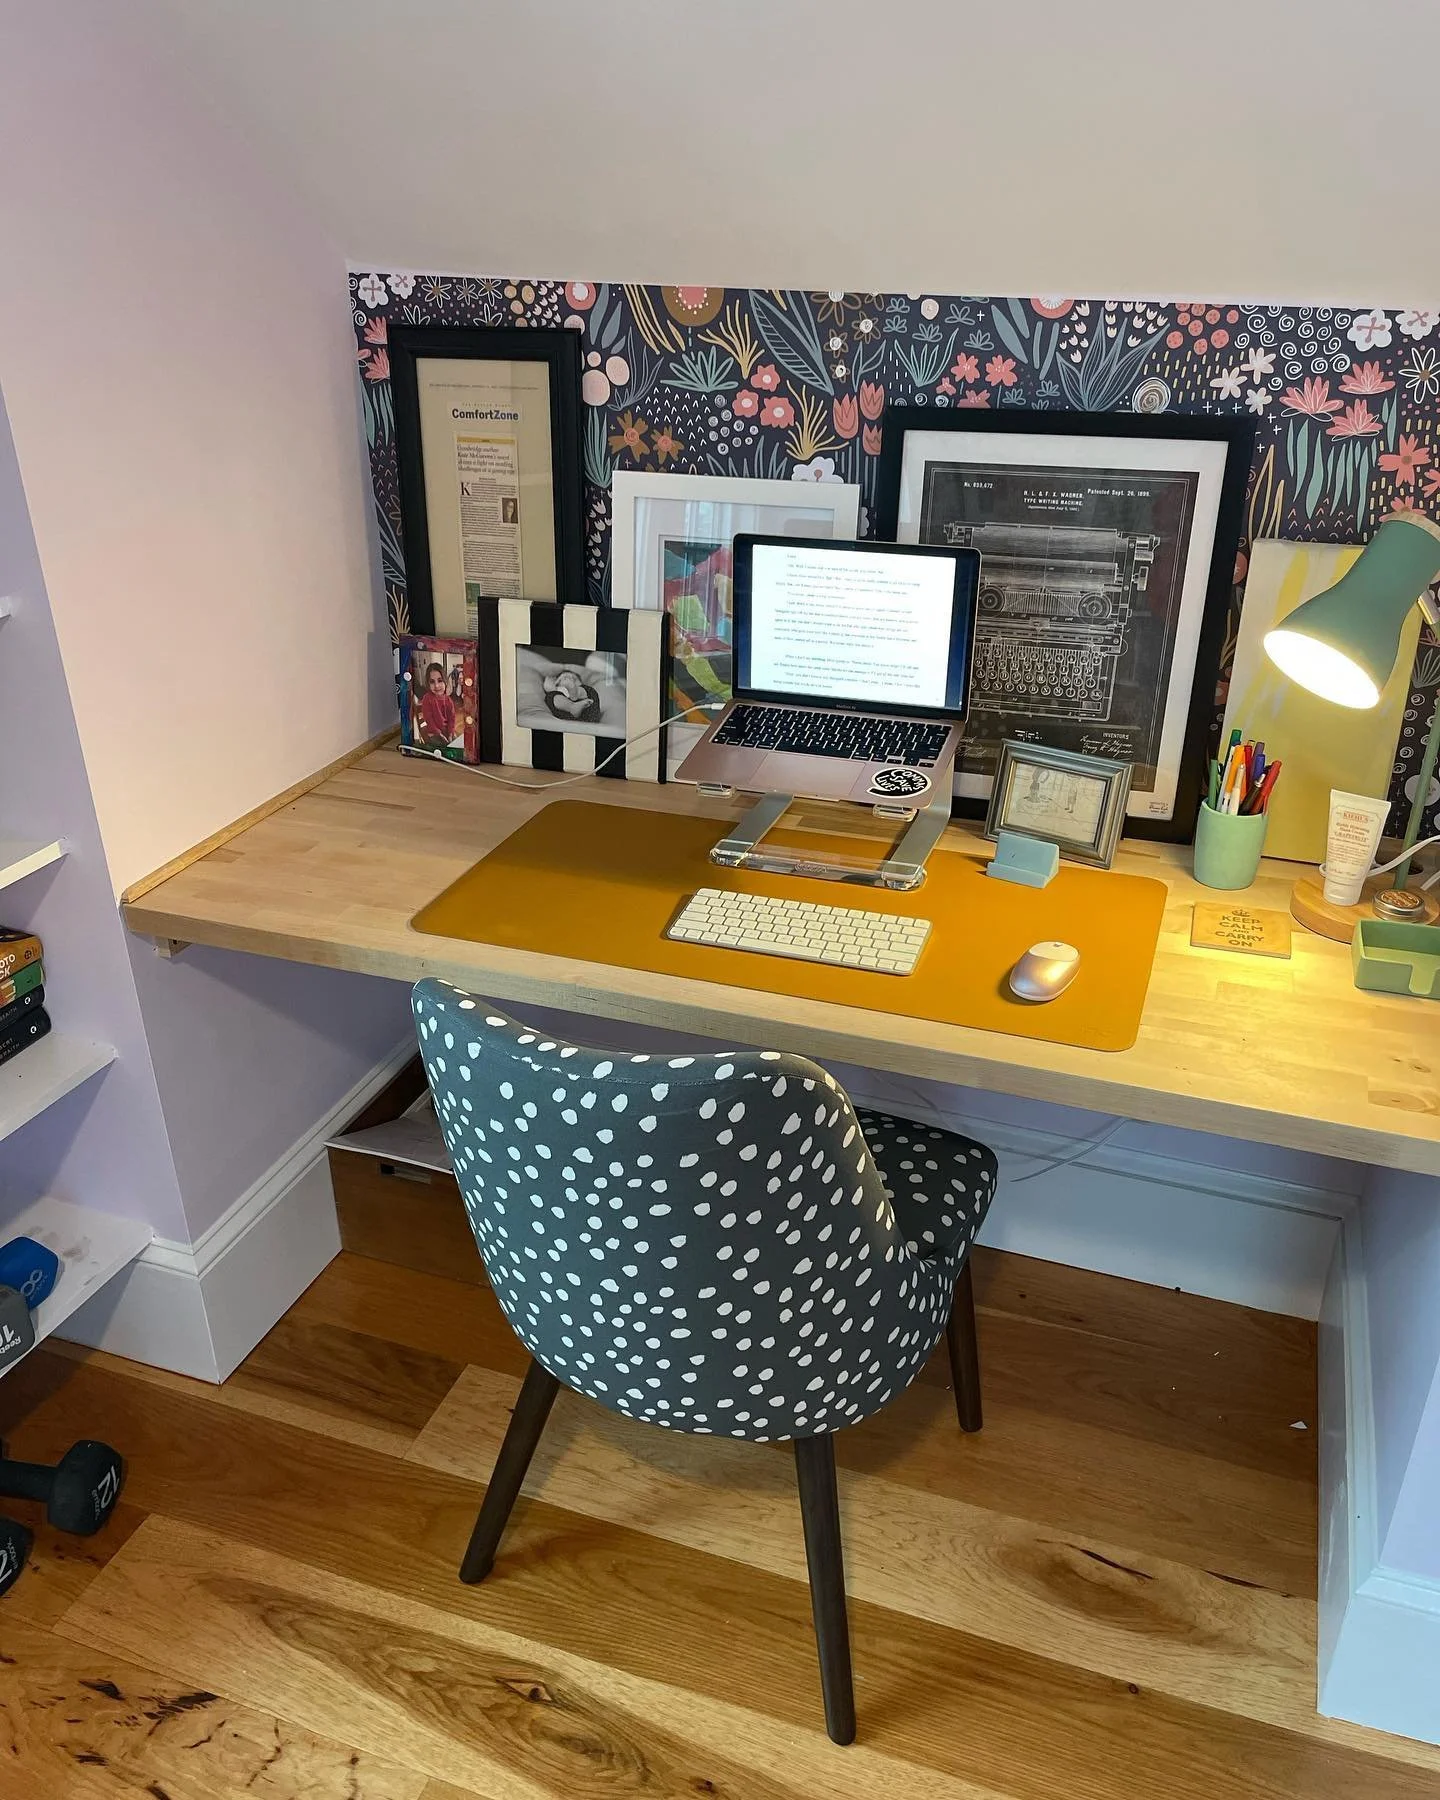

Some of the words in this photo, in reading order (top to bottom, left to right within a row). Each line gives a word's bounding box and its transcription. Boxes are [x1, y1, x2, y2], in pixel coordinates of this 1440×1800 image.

[452, 408, 519, 421] ComfortZone
[461, 482, 471, 496] K
[877, 774, 901, 791] LIVES
[890, 775, 913, 792] SAVE
[1219, 921, 1263, 932] CALM
[1222, 915, 1261, 925] KEEP
[1214, 931, 1265, 942] CARRY
[1228, 939, 1253, 948] ON
[20, 1269, 43, 1298] 8
[97, 1464, 120, 1509] 12
